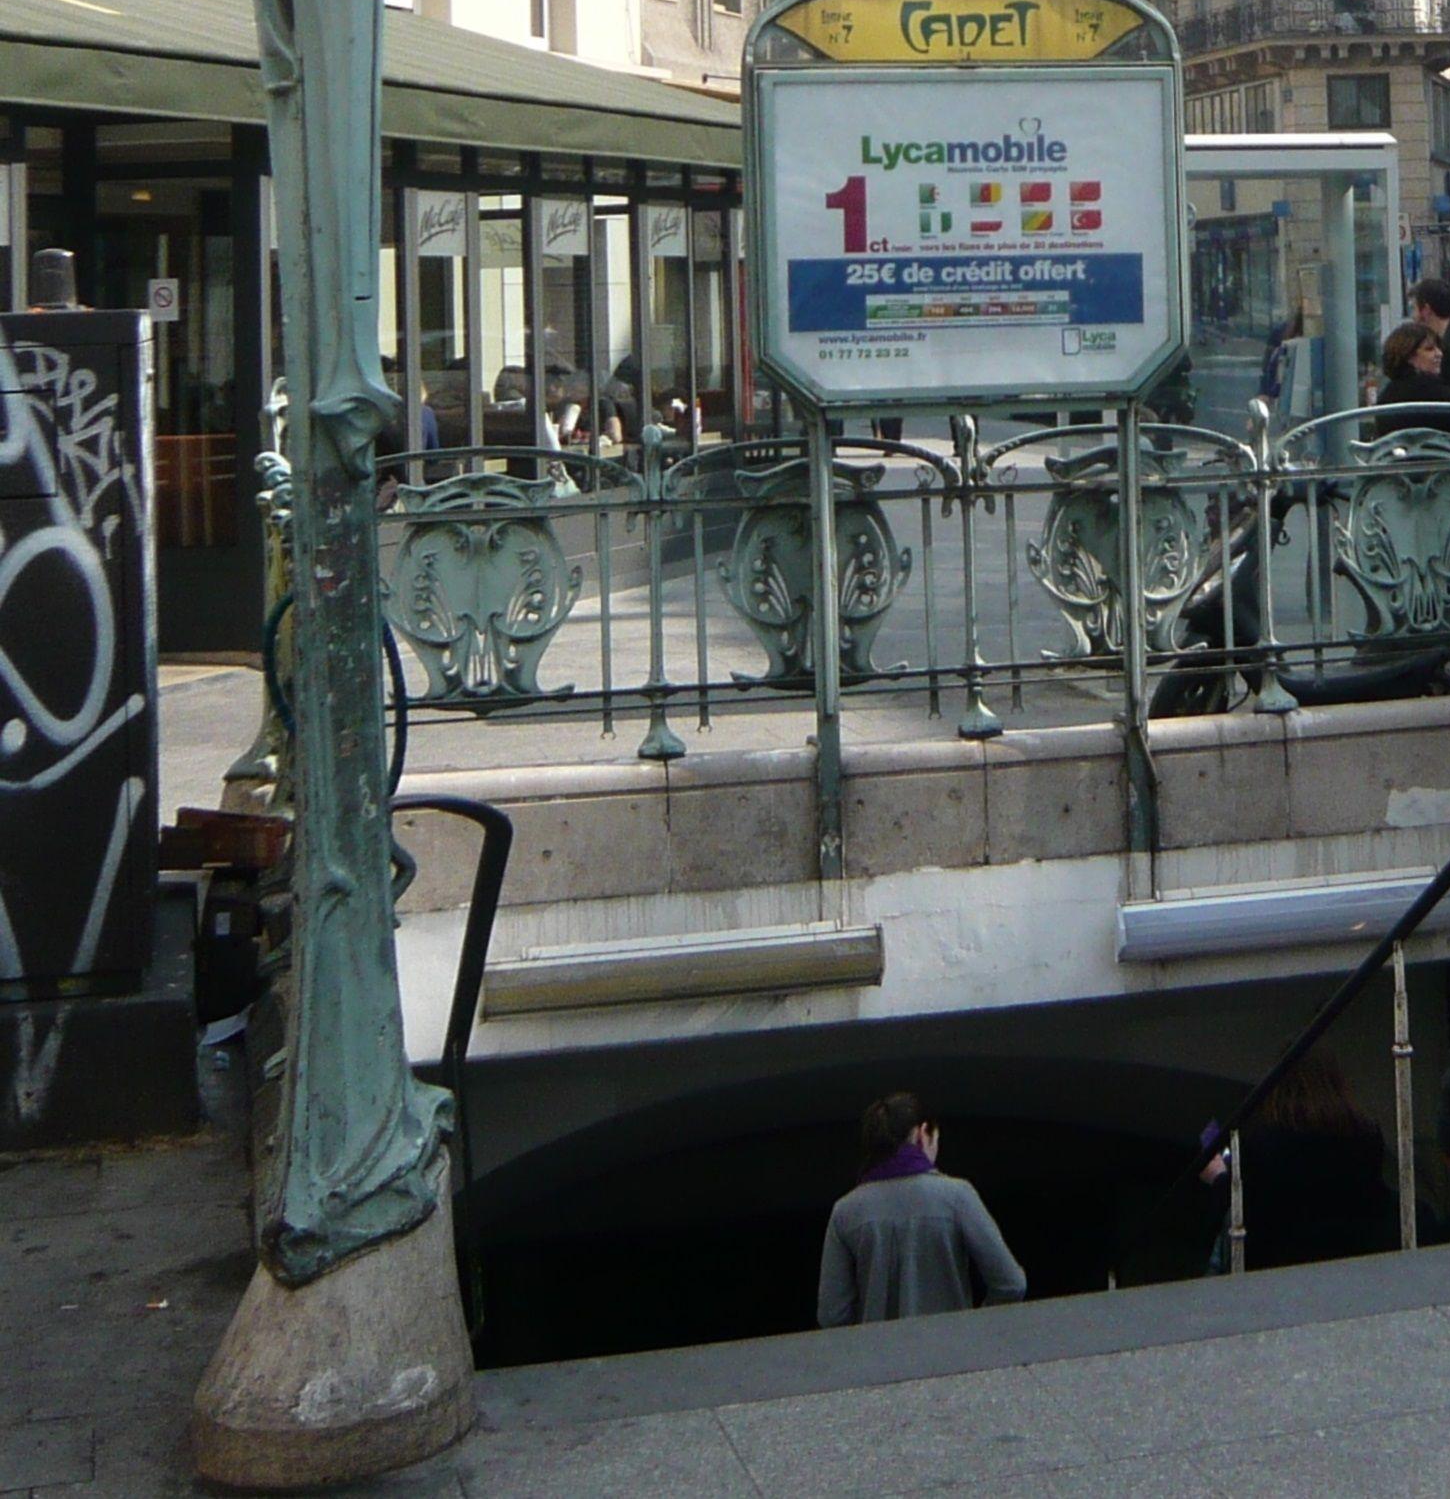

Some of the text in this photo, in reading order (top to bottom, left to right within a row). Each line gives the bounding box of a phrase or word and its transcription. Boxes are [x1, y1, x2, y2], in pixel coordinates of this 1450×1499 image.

[901, 0, 1041, 54] CADET
[861, 133, 1068, 170] Lycamobile
[825, 175, 867, 253] 1
[845, 259, 1086, 286] 25€ de crédit offert
[818, 332, 928, 345] www.lycamobile.fr
[1082, 330, 1117, 344] Lyca
[818, 349, 834, 359] 01
[838, 348, 853, 359] 77
[857, 348, 873, 359] 72
[894, 346, 910, 357] 22
